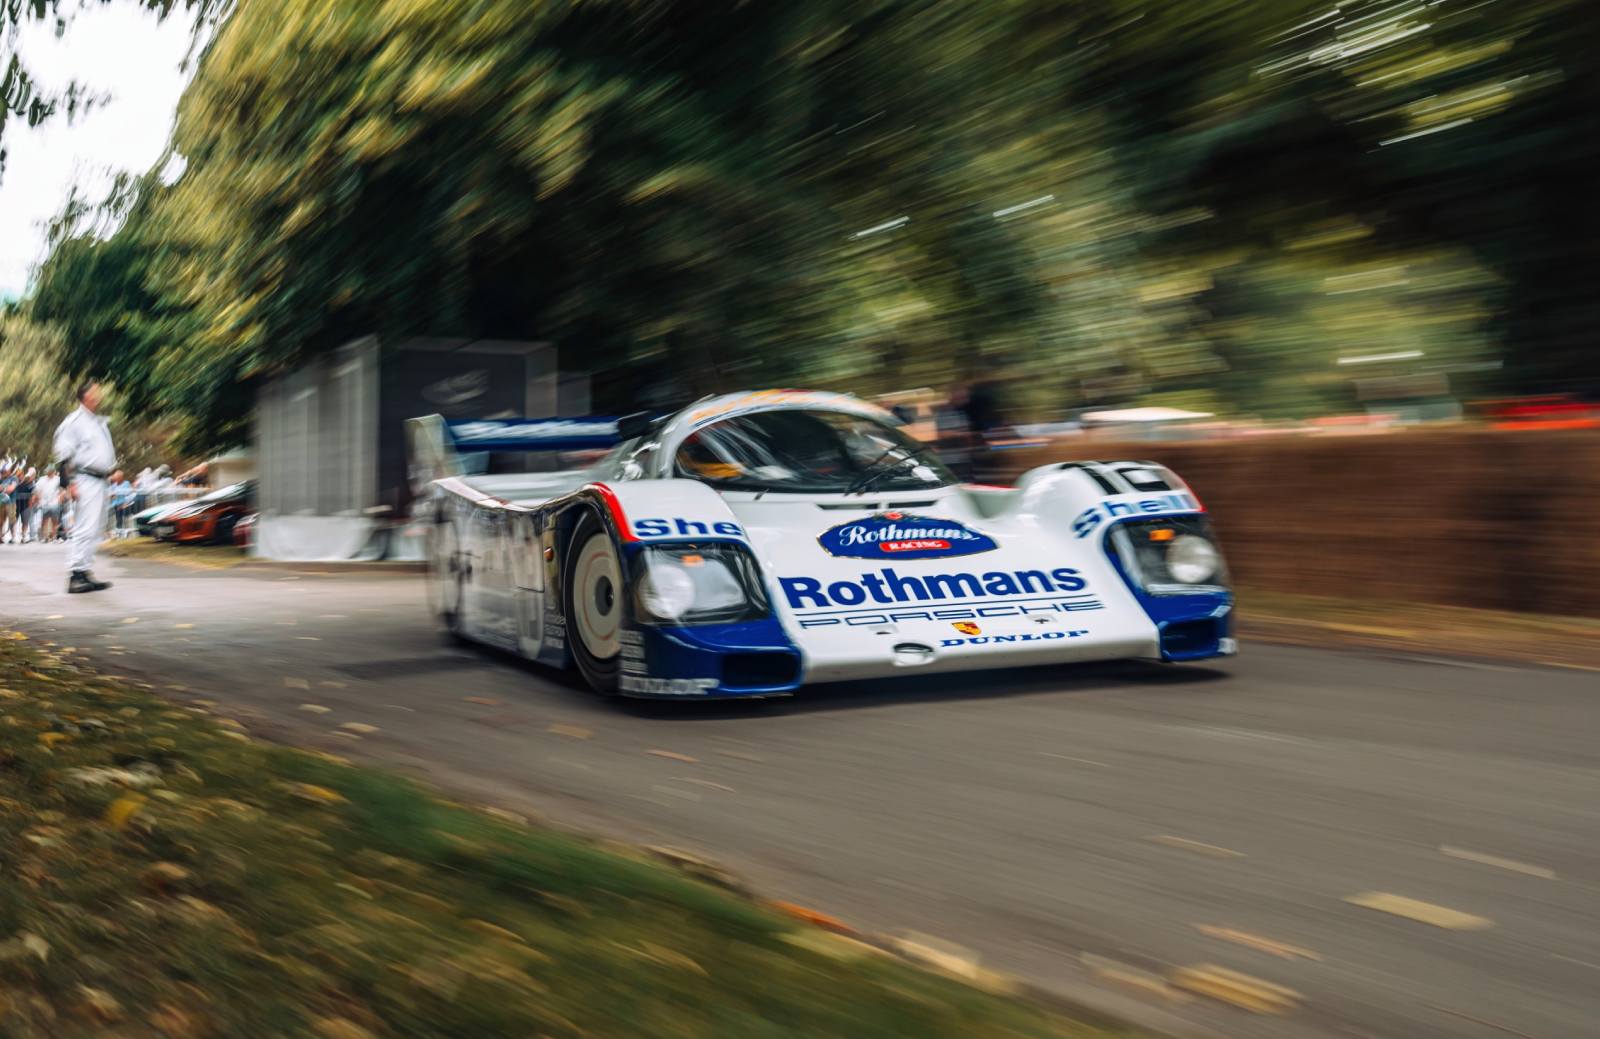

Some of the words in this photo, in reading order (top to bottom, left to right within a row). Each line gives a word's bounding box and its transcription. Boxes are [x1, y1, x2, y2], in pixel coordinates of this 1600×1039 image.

[839, 524, 980, 546] Rothmans
[889, 540, 943, 550] RACING
[778, 567, 1087, 608] Rothmans
[798, 600, 1106, 629] PORSCHE
[940, 630, 1089, 647] DUNLOP
